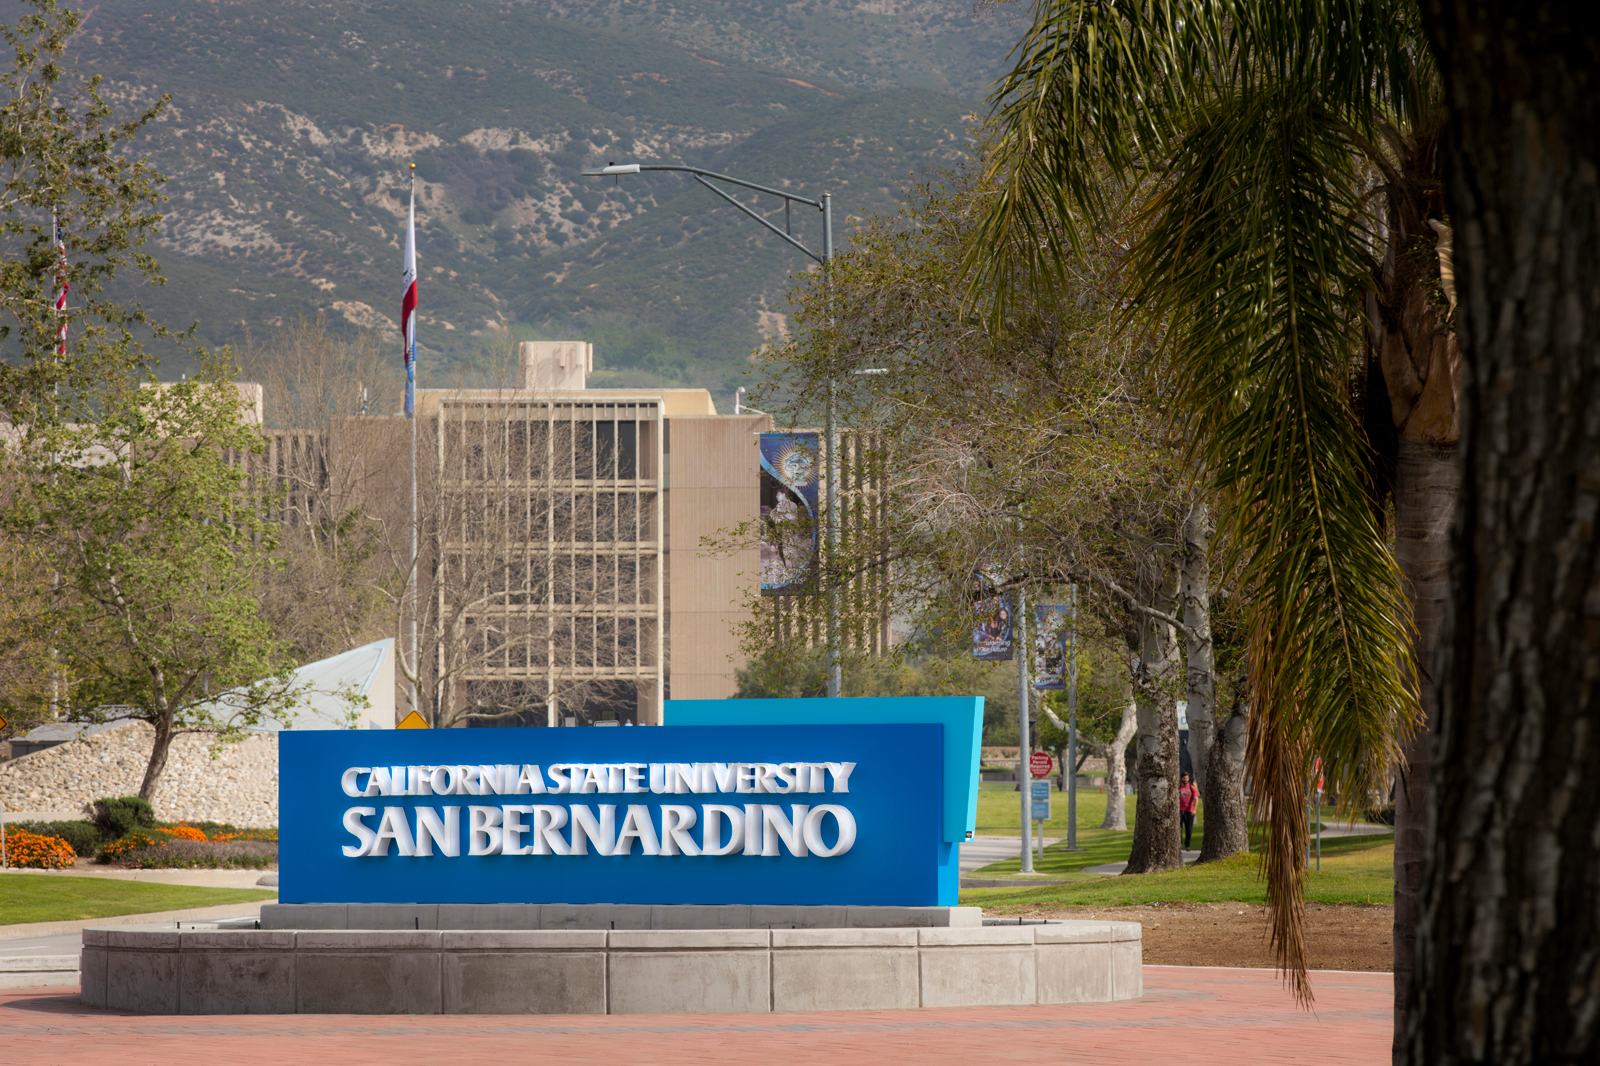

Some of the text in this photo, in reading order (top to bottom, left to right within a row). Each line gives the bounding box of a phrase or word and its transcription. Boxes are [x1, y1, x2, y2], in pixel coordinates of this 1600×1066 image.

[341, 762, 857, 797] CALIFORNIA STATE UNIVERSITY
[342, 804, 857, 857] SAN BERNARDINO
